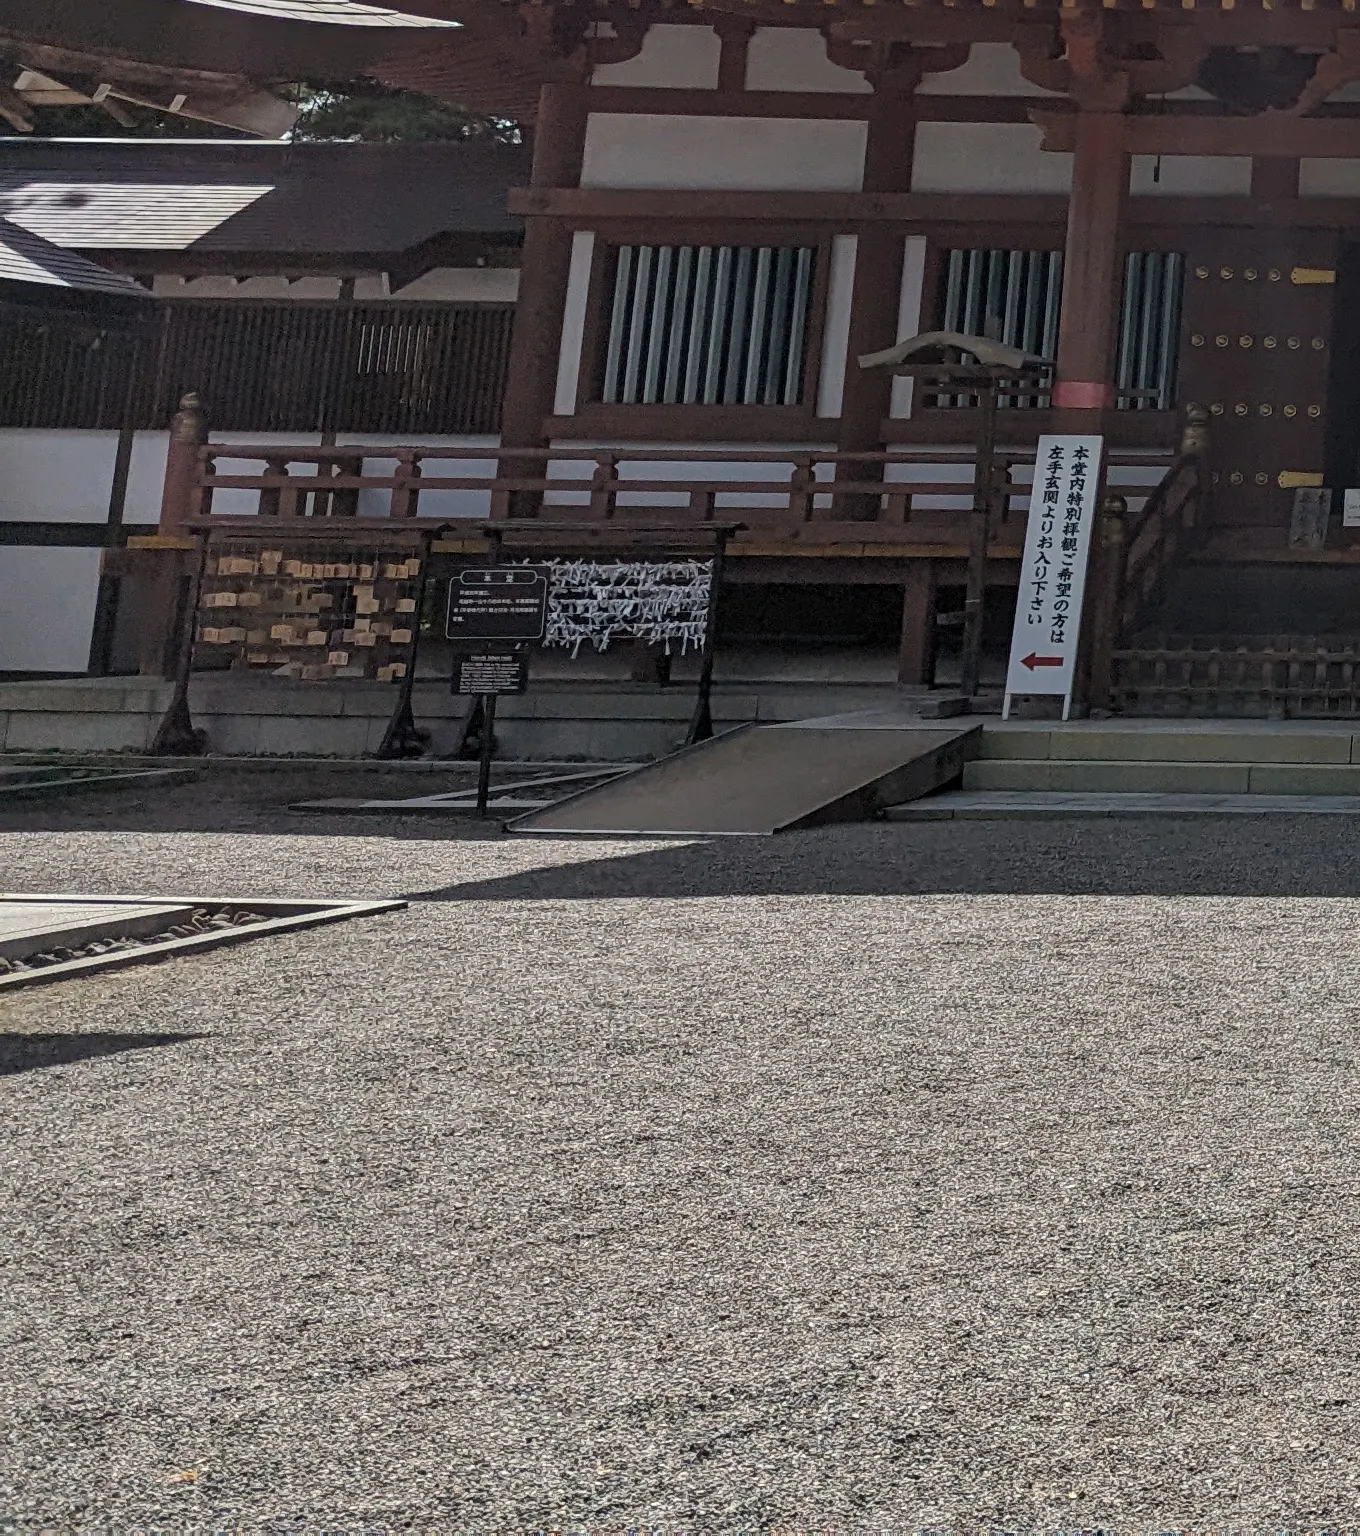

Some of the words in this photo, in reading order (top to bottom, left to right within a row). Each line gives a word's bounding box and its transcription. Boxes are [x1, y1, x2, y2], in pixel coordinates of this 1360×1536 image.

[1027, 444, 1065, 625] 左手玄関よりお入り下さい
[1050, 445, 1090, 644] 本堂内特別拝観ご希望の方は
